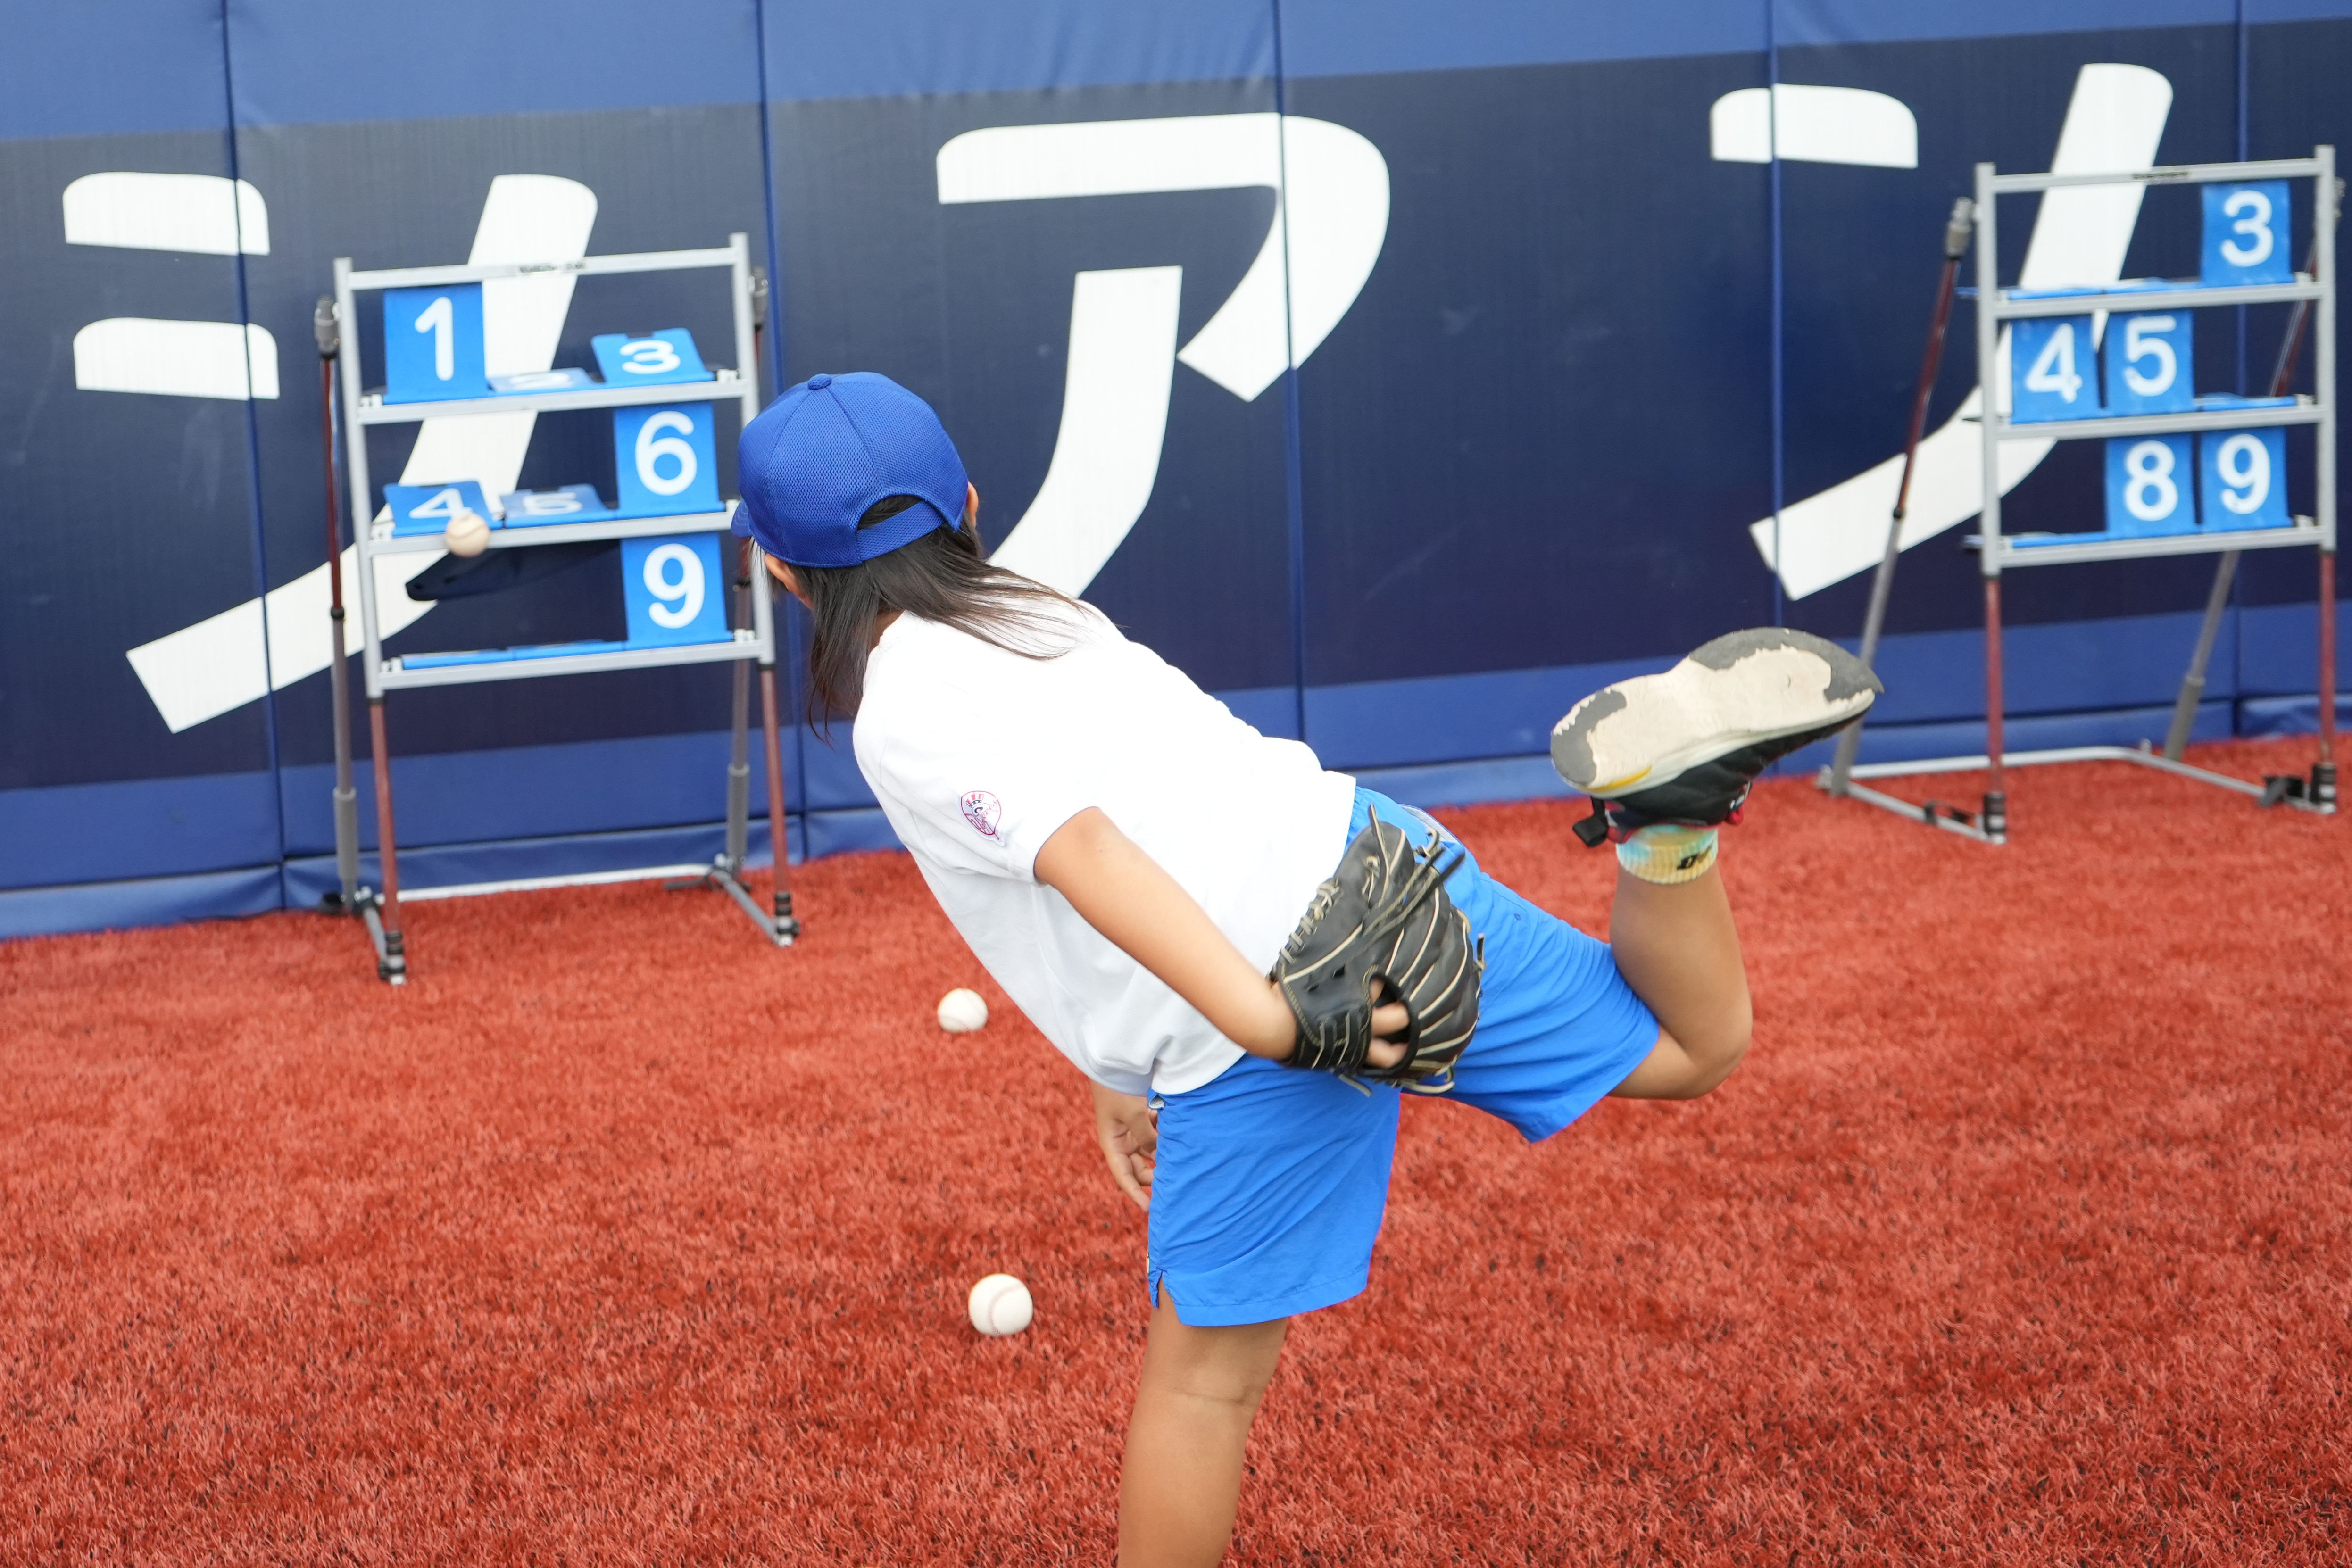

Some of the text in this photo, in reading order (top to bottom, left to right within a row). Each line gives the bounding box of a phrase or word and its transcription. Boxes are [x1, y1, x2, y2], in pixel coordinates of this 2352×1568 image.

[2221, 190, 2273, 267] 3
[414, 297, 455, 381] 1
[619, 340, 681, 375] 3
[2025, 316, 2177, 403] 4 5
[409, 411, 698, 521] 4 5 6
[2124, 434, 2270, 522] 8 9
[643, 543, 706, 629] 9
